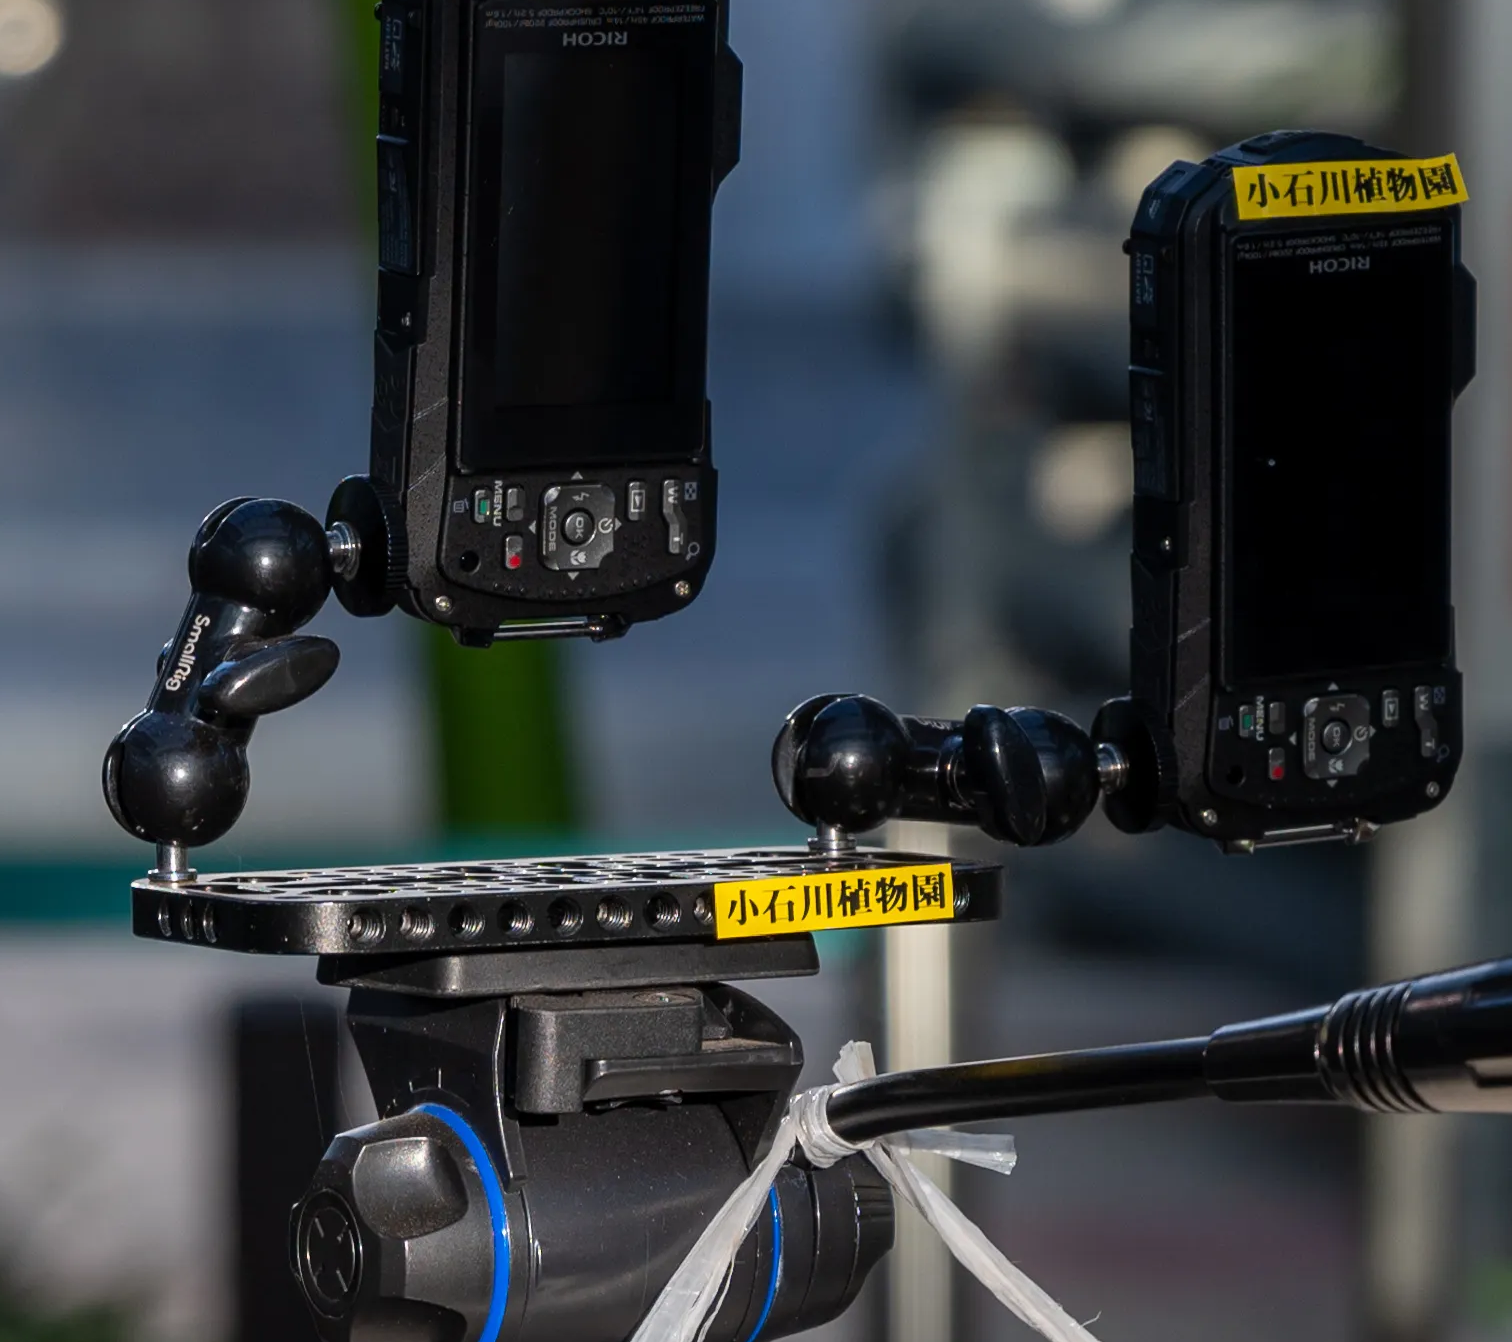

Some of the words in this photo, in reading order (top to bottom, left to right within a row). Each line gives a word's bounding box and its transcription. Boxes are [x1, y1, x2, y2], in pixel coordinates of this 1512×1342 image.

[562, 31, 629, 47] RICOH
[1248, 163, 1457, 208] 小石川植物園
[1308, 255, 1371, 275] RICOH
[492, 480, 503, 527] MENU
[548, 506, 557, 552] MODE
[574, 516, 585, 539] OK
[165, 613, 211, 692] SmallRig
[1255, 695, 1265, 741] MENU
[1307, 717, 1316, 761] MODE
[1331, 727, 1341, 747] OK
[726, 871, 949, 926] 小石川植物園
